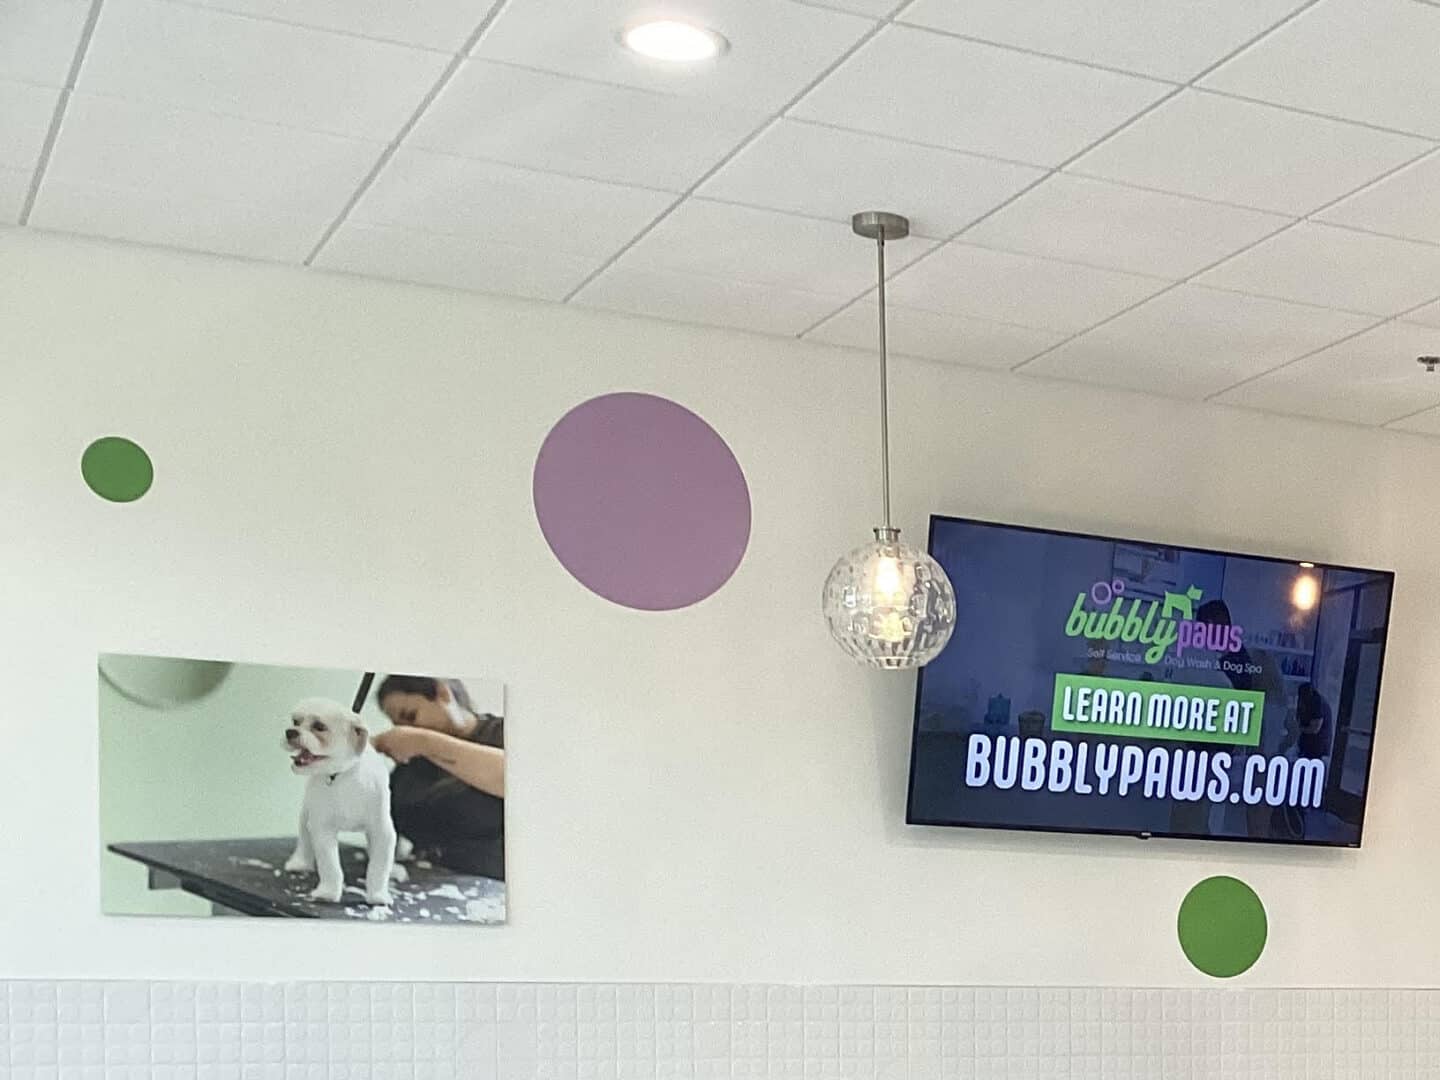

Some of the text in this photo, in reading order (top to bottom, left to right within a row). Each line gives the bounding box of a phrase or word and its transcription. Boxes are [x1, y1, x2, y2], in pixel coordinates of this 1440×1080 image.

[1106, 649, 1141, 663] Service
[1164, 655, 1184, 668] Dog
[1223, 660, 1243, 674] Dog
[1245, 662, 1262, 674] Spa
[1062, 686, 1255, 735] LEARN MORE AT
[965, 734, 1325, 808] BUBBLYPAWS.COM
